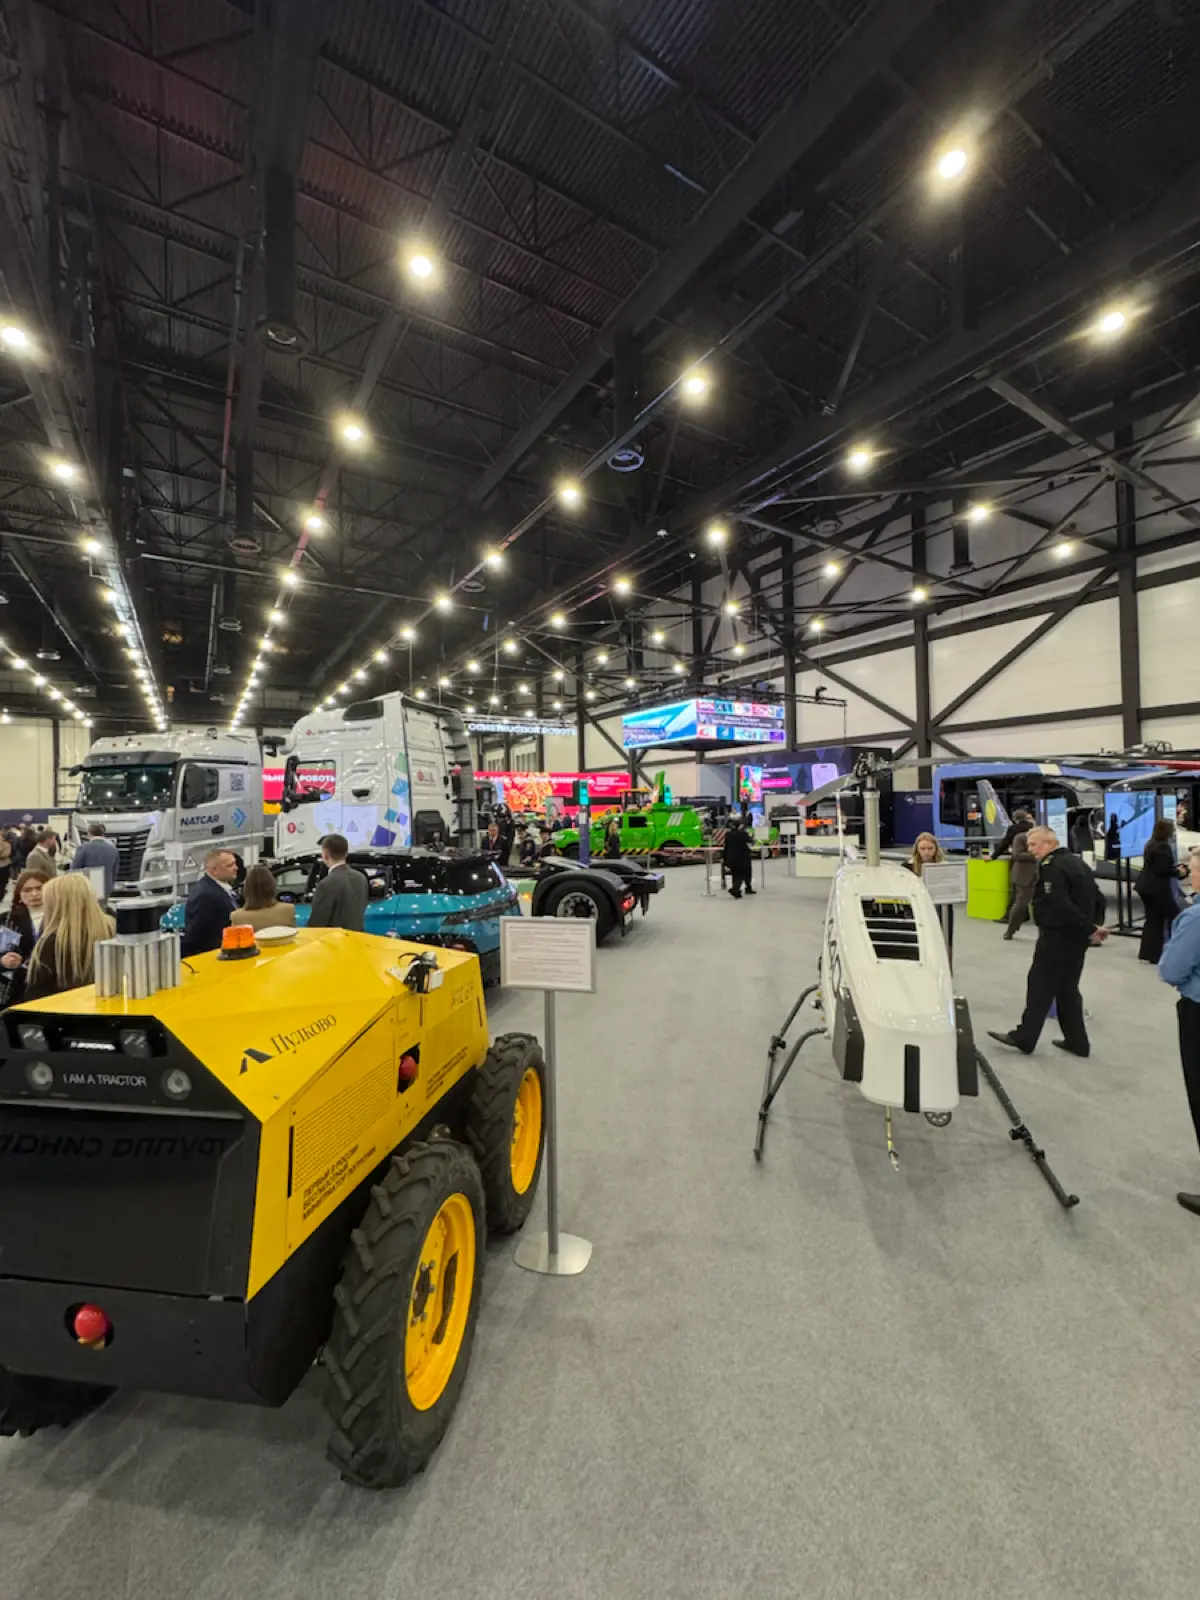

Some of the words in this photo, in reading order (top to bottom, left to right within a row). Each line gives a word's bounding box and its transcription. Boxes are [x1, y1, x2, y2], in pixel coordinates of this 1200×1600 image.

[180, 814, 220, 826] NATCAR
[63, 1073, 68, 1084] I
[69, 1074, 86, 1085] AM
[87, 1074, 97, 1085] A
[96, 1074, 147, 1087] TRACTOR
